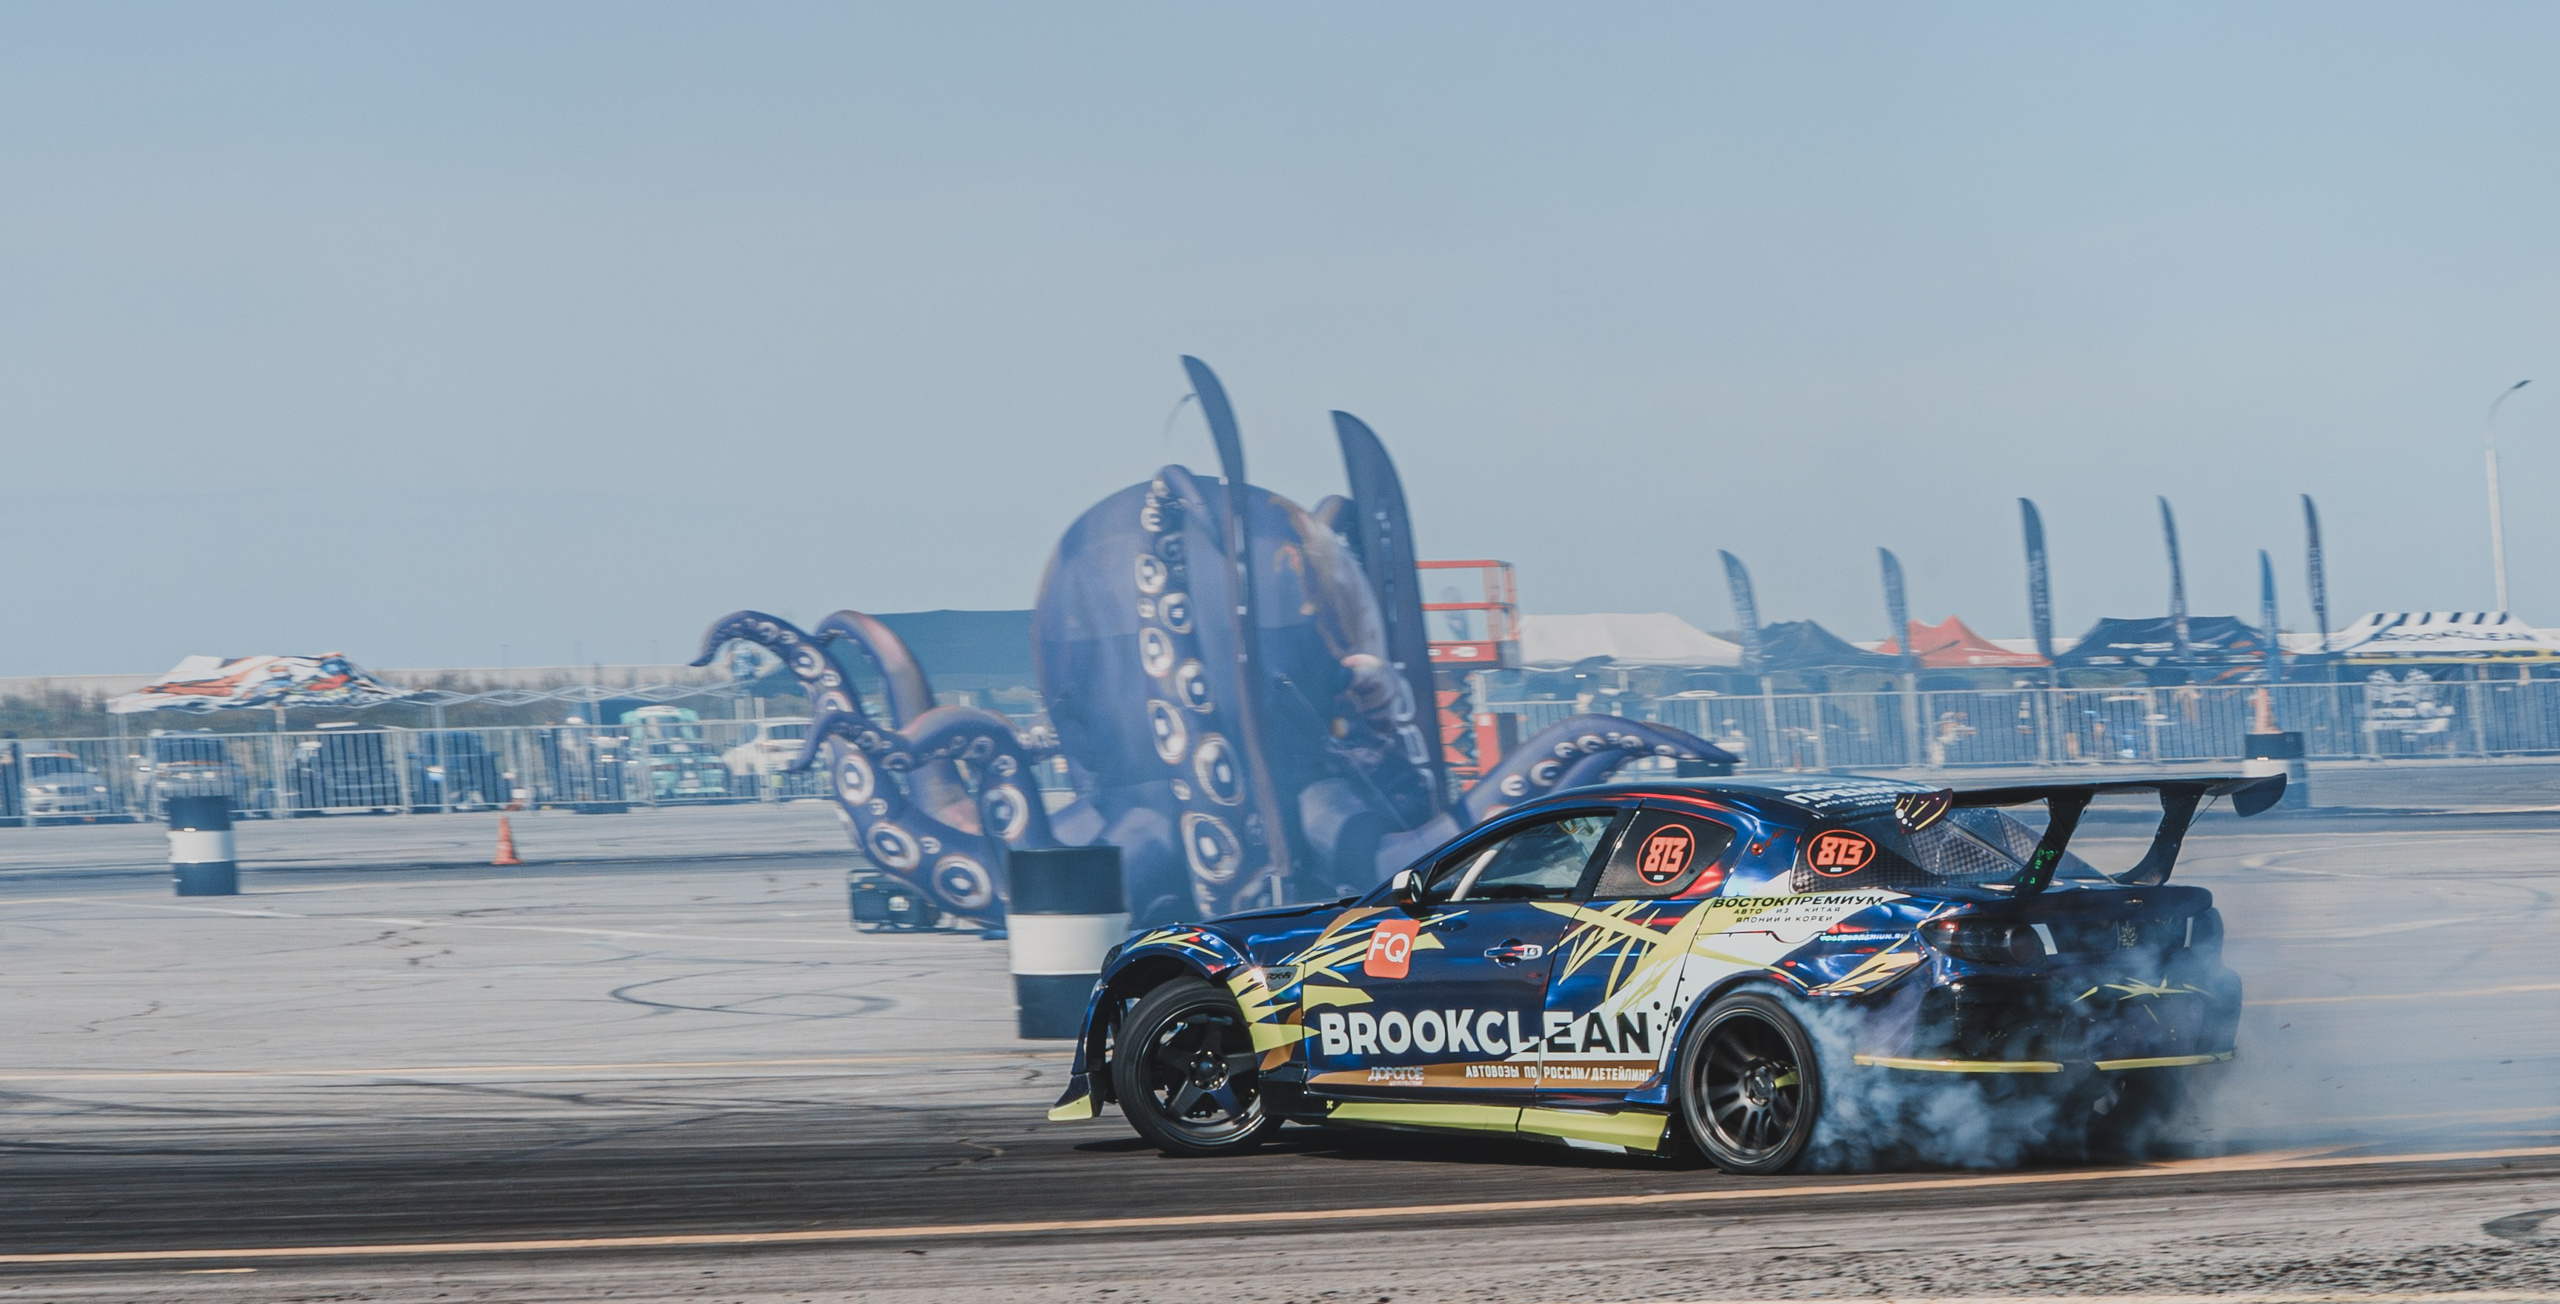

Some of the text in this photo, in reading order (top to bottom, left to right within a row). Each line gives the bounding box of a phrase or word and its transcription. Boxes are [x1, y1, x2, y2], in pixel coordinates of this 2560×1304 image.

[1643, 836, 1689, 873] 813
[1816, 836, 1867, 866] 813
[1712, 895, 1884, 908] ВОСТОКПРЕМИУМ
[1368, 931, 1410, 963] FQ
[1319, 1008, 1651, 1056] BROOKCLEAN
[1367, 1066, 1425, 1082] ДОРОГОЕ
[1465, 1065, 1520, 1078] АВТОВОЗЫ
[1523, 1066, 1538, 1079] ПО
